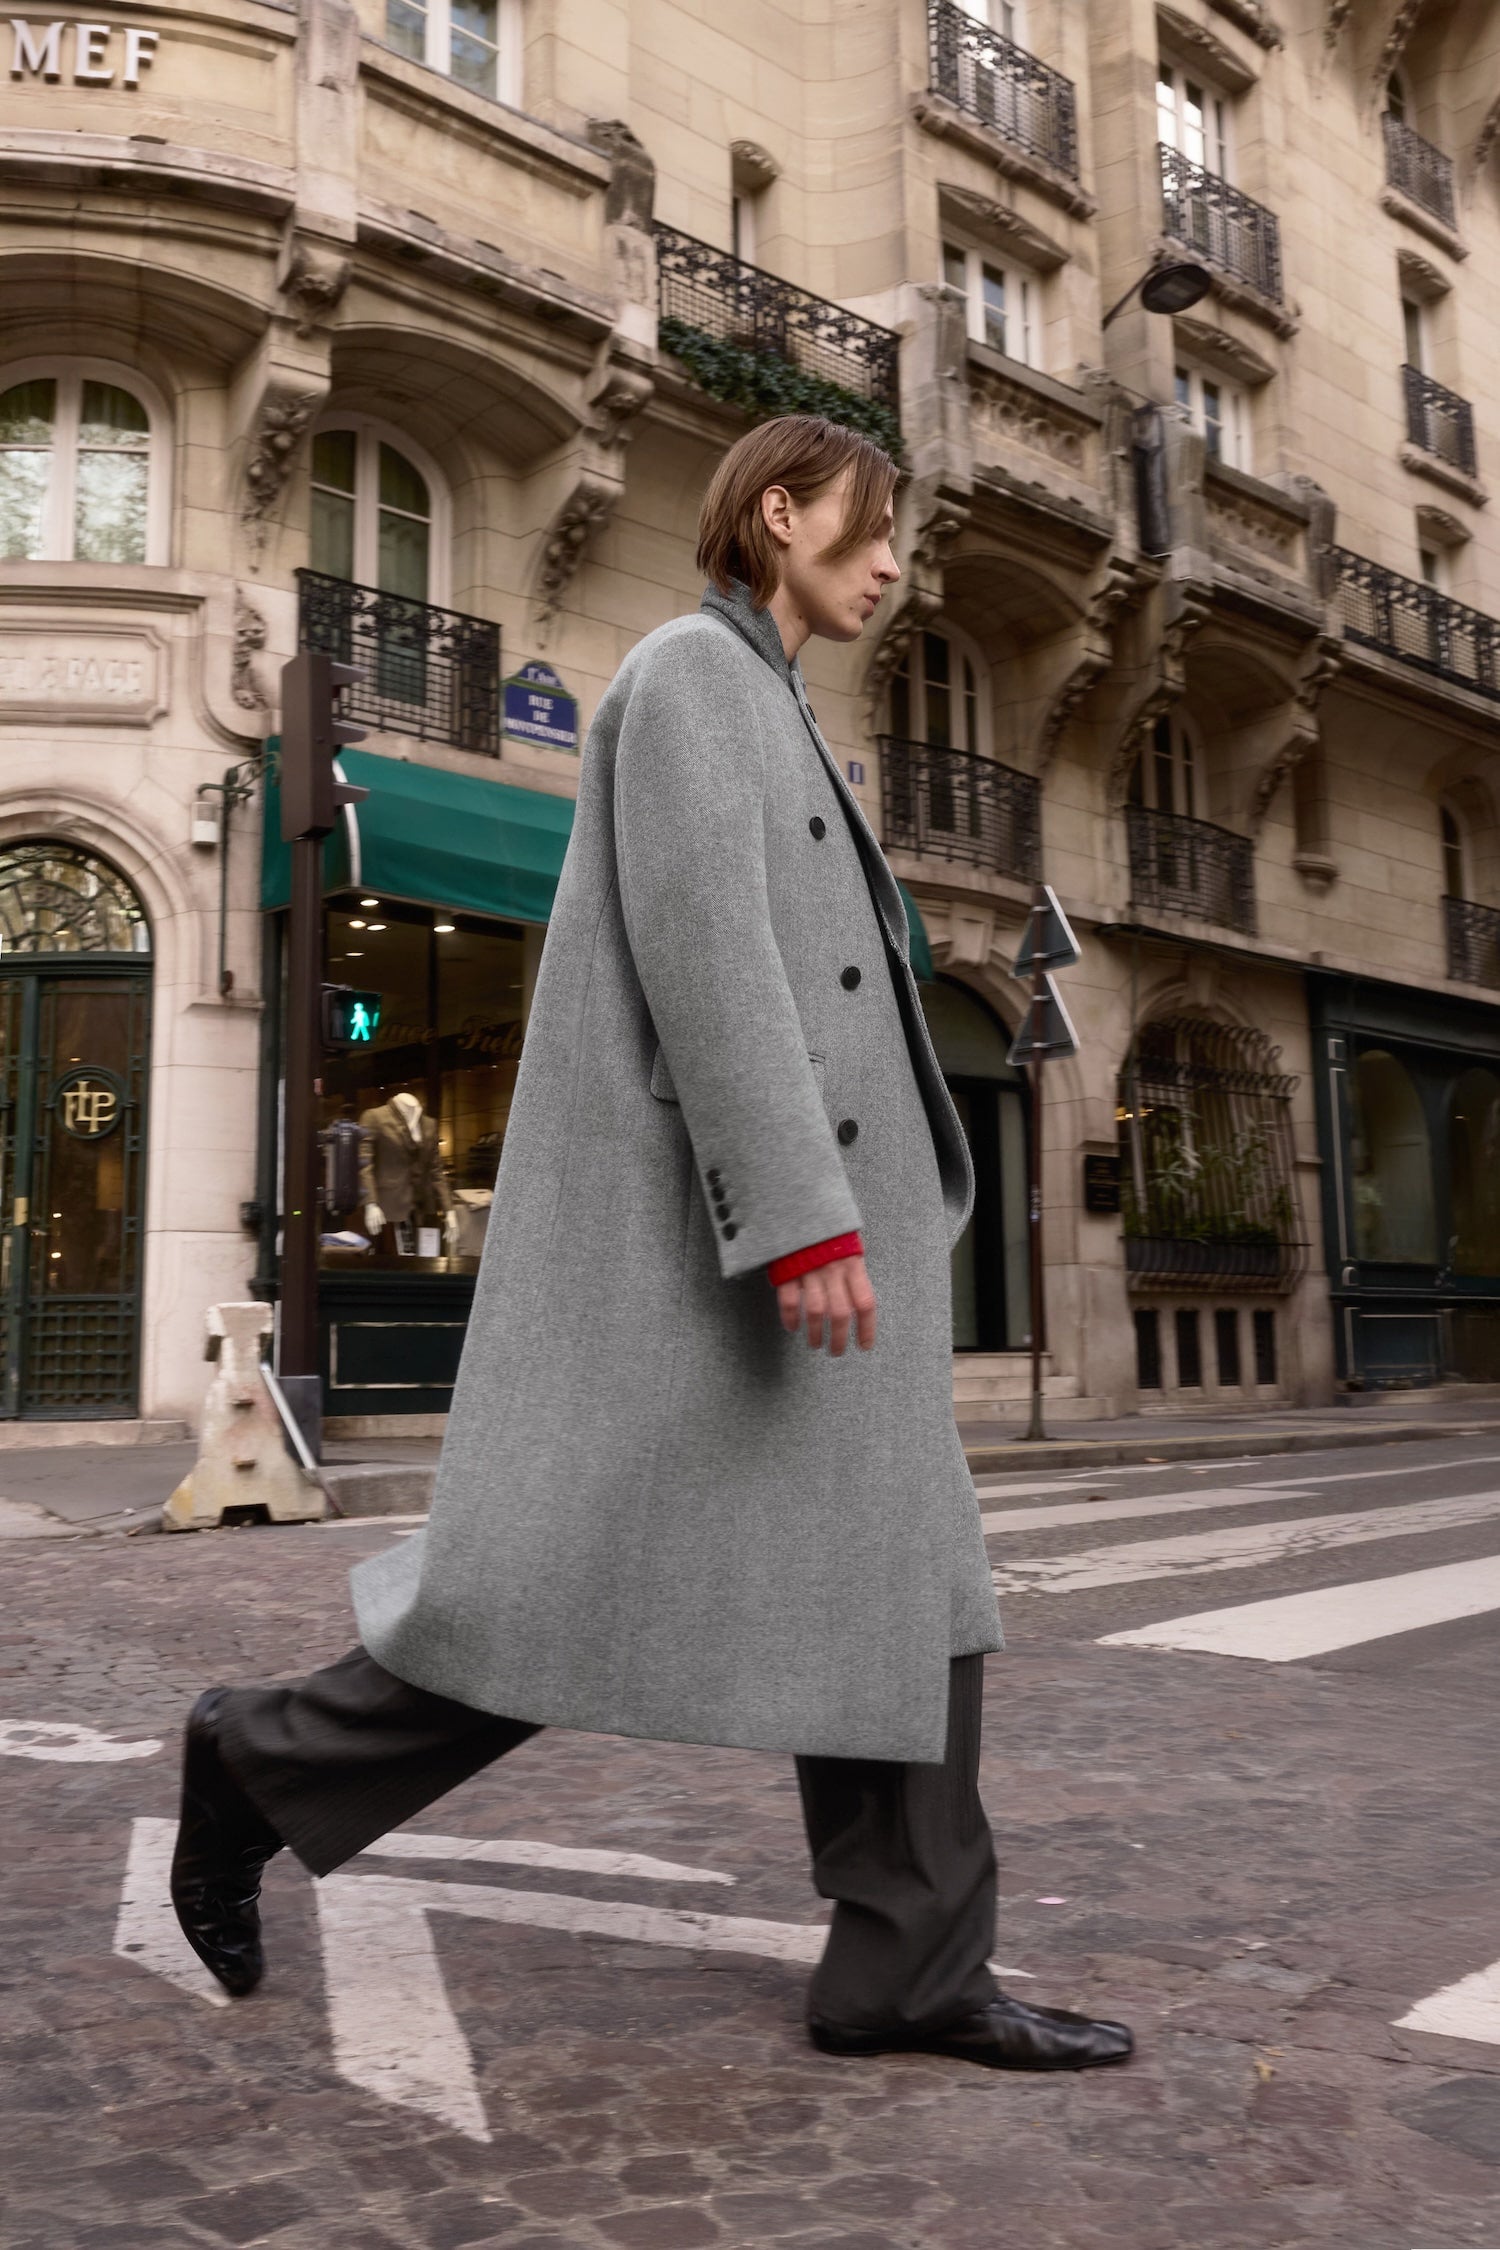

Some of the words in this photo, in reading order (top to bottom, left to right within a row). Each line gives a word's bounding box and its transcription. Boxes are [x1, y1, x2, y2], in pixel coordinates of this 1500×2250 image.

[9, 19, 160, 86] MEF
[528, 694, 554, 710] RUE
[532, 710, 551, 723] DE
